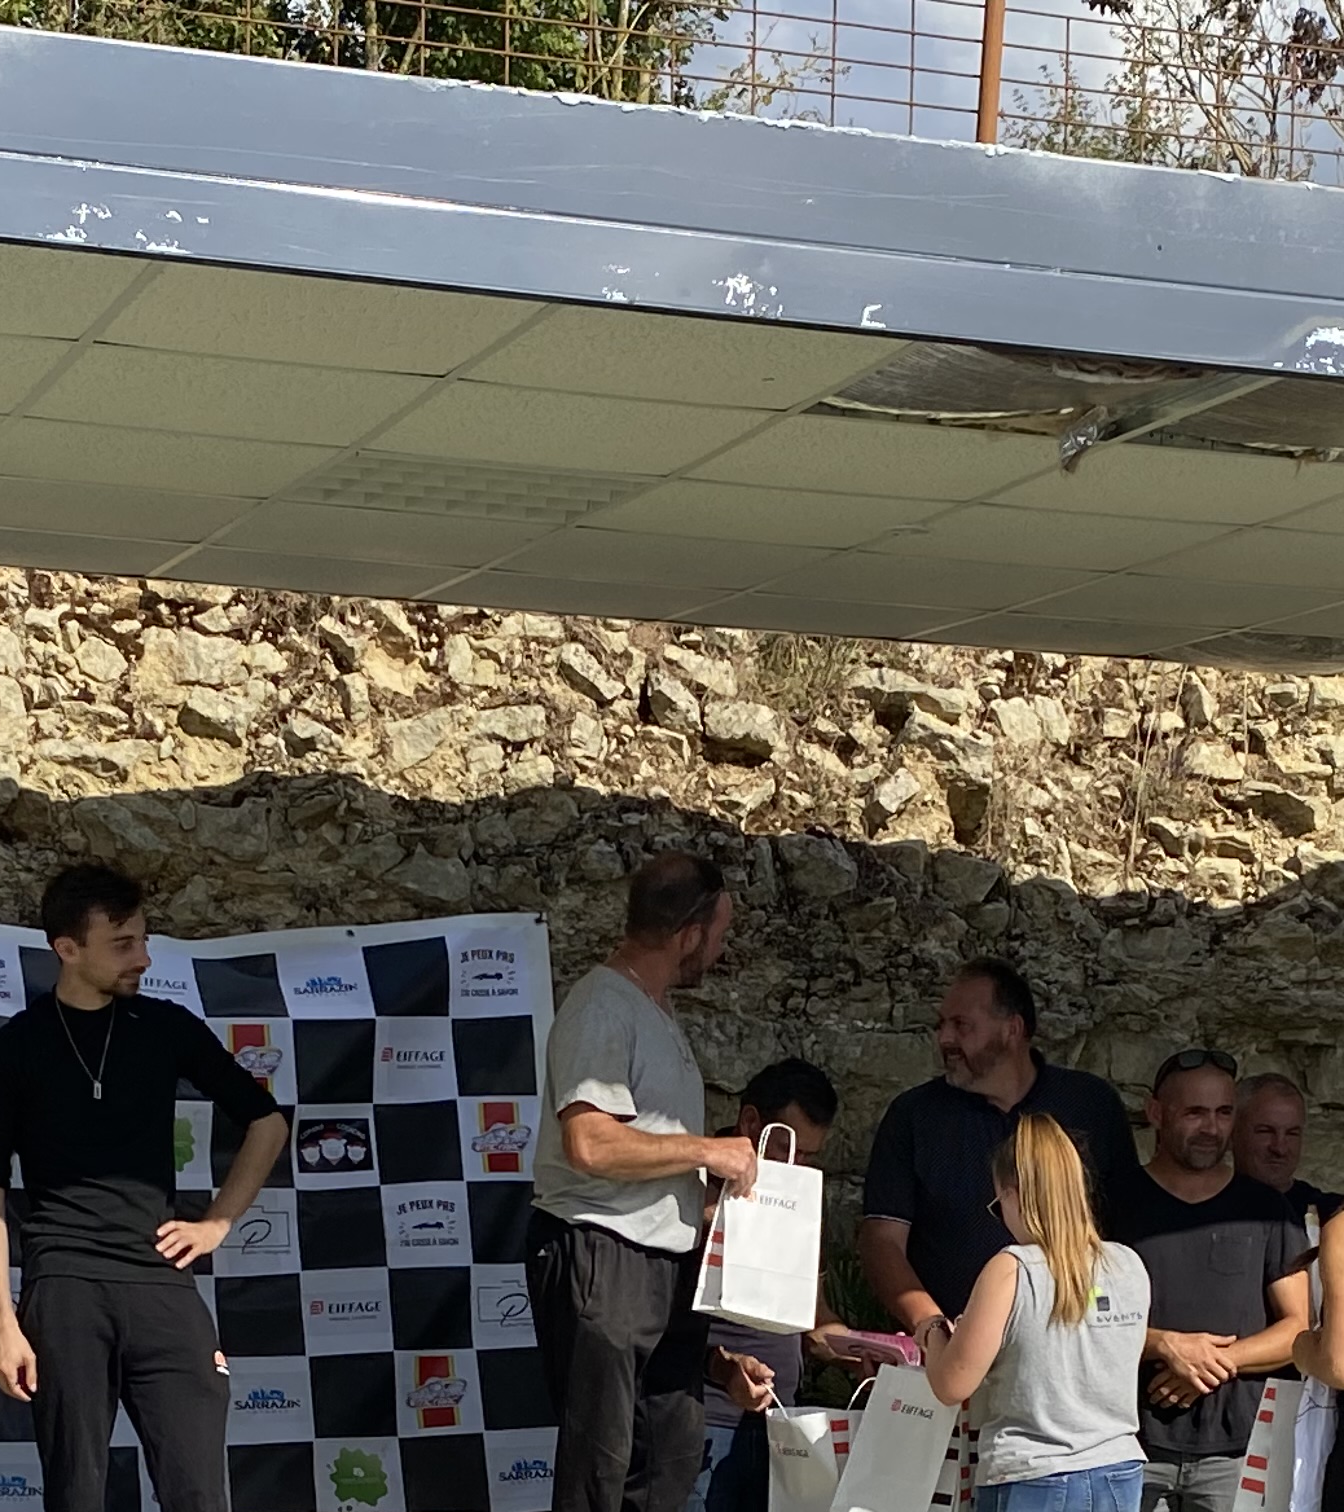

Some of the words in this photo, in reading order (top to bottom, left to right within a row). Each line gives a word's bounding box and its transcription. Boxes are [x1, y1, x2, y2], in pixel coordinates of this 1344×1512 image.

[460, 950, 470, 964] JE
[471, 949, 494, 961] PEUX
[496, 949, 515, 964] PAS
[141, 976, 188, 990] IFFAGE
[396, 1050, 446, 1062] EIFFAGE
[396, 1203, 408, 1215] JE
[409, 1199, 434, 1212] PEUX
[436, 1199, 456, 1213] PAS
[759, 1194, 798, 1211] EIFFAGE
[328, 1300, 382, 1315] EIFFAGE
[1096, 1312, 1143, 1324] EVENTS
[234, 1399, 302, 1411] SARRAZIN
[900, 1403, 935, 1420] EIFFAGE
[498, 1468, 554, 1482] SARRAZI
